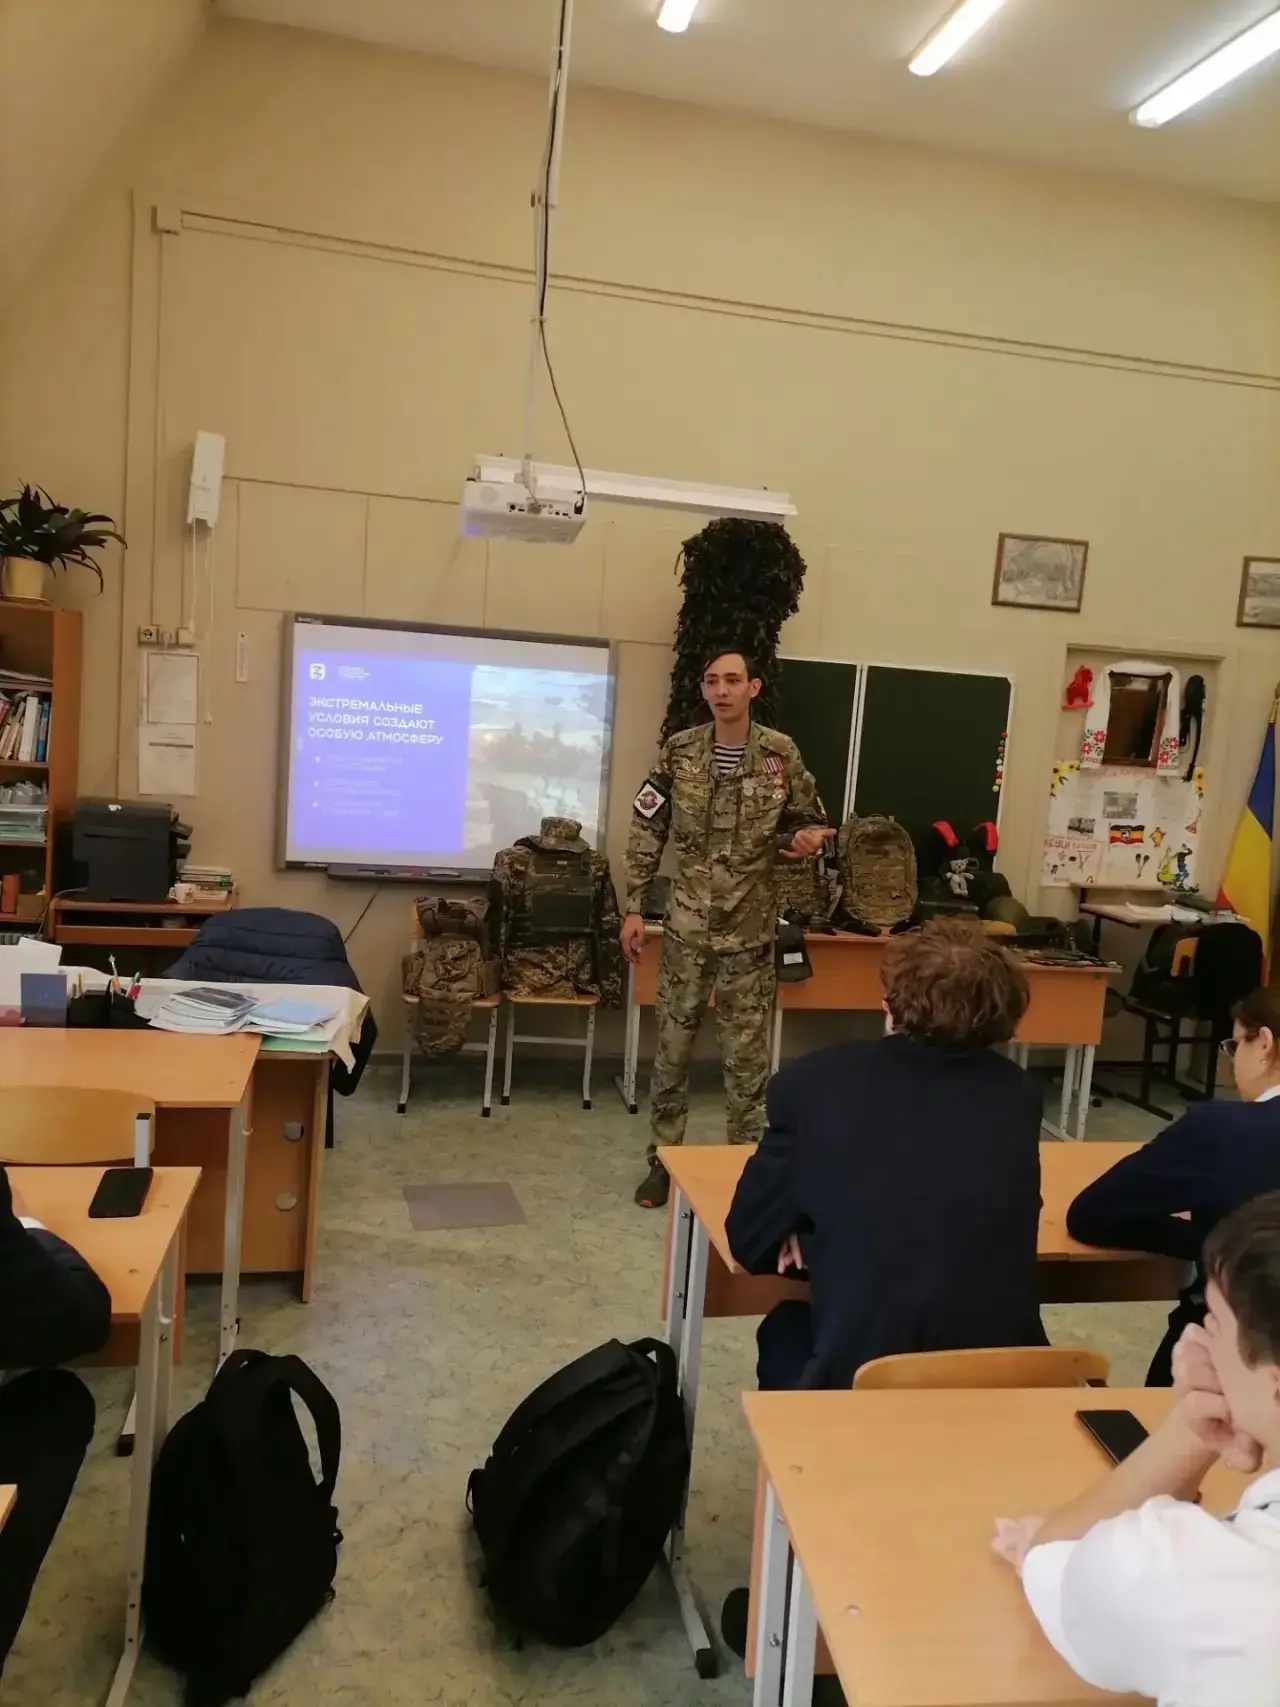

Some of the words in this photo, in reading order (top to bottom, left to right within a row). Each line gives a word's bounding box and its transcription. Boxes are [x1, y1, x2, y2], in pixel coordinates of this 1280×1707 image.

[308, 697, 424, 714] ЭКСТРЕМАЛЬНЫЕ
[308, 712, 369, 725] УСЛОВИЯ
[373, 717, 436, 729] СОЗДАЮТ
[307, 728, 363, 740] ОСОБУЮ
[367, 731, 443, 745] АТМОСФЕРУ
